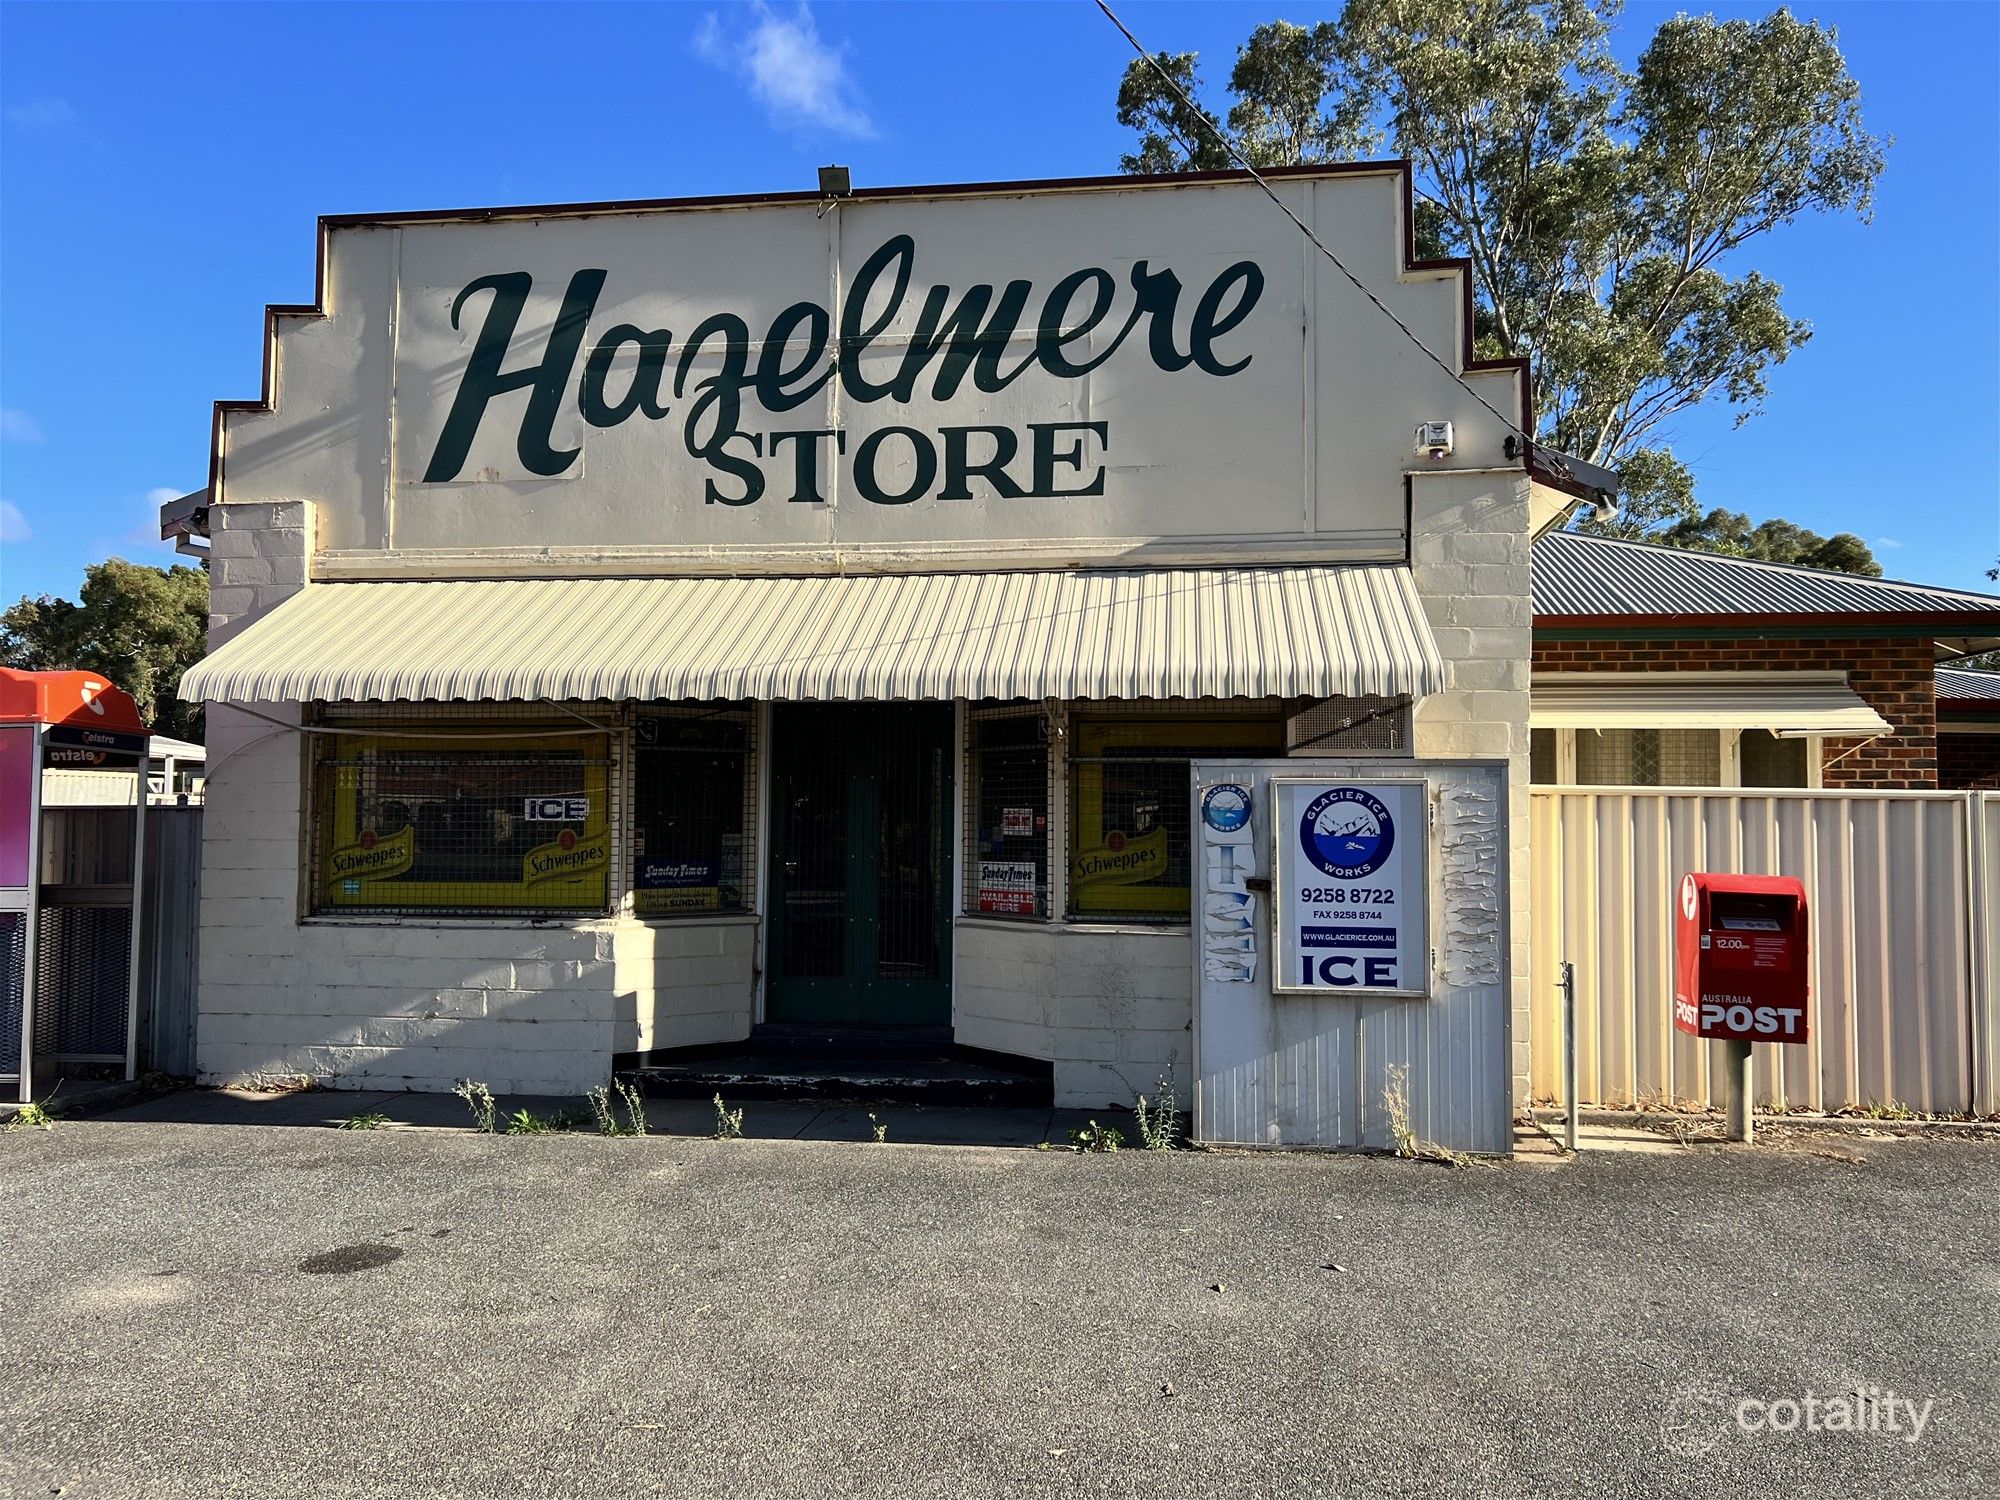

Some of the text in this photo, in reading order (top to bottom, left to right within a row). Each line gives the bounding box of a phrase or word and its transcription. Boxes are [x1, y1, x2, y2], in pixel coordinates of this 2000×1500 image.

[423, 234, 1265, 483] Hazelmere
[704, 420, 1109, 506] STORE
[1206, 786, 1248, 802] GLACIER ICE
[530, 799, 587, 820] ICE
[1307, 791, 1388, 821] GLACIER ICE
[1213, 822, 1241, 831] WORKS
[332, 845, 404, 876] Schweppes
[531, 845, 604, 877] Schweppes
[1078, 848, 1156, 879] Schweppes
[645, 864, 708, 878] Sunday Times
[982, 866, 1033, 881] Sunday Times
[1324, 862, 1372, 877] WORKS
[669, 899, 705, 908] SUNDAY
[980, 891, 1034, 904] AVAILABLE
[1301, 887, 1395, 905] 9258 8722
[992, 902, 1020, 913] HERE
[1313, 910, 1382, 920] FAX 9258 8744
[1302, 932, 1395, 942] WWW.GLACIERICE.COM.AU
[1301, 955, 1398, 988] ICE
[1701, 994, 1752, 1004] AUSTRALIA
[1676, 999, 1698, 1026] POST
[1701, 1004, 1802, 1034] POST
